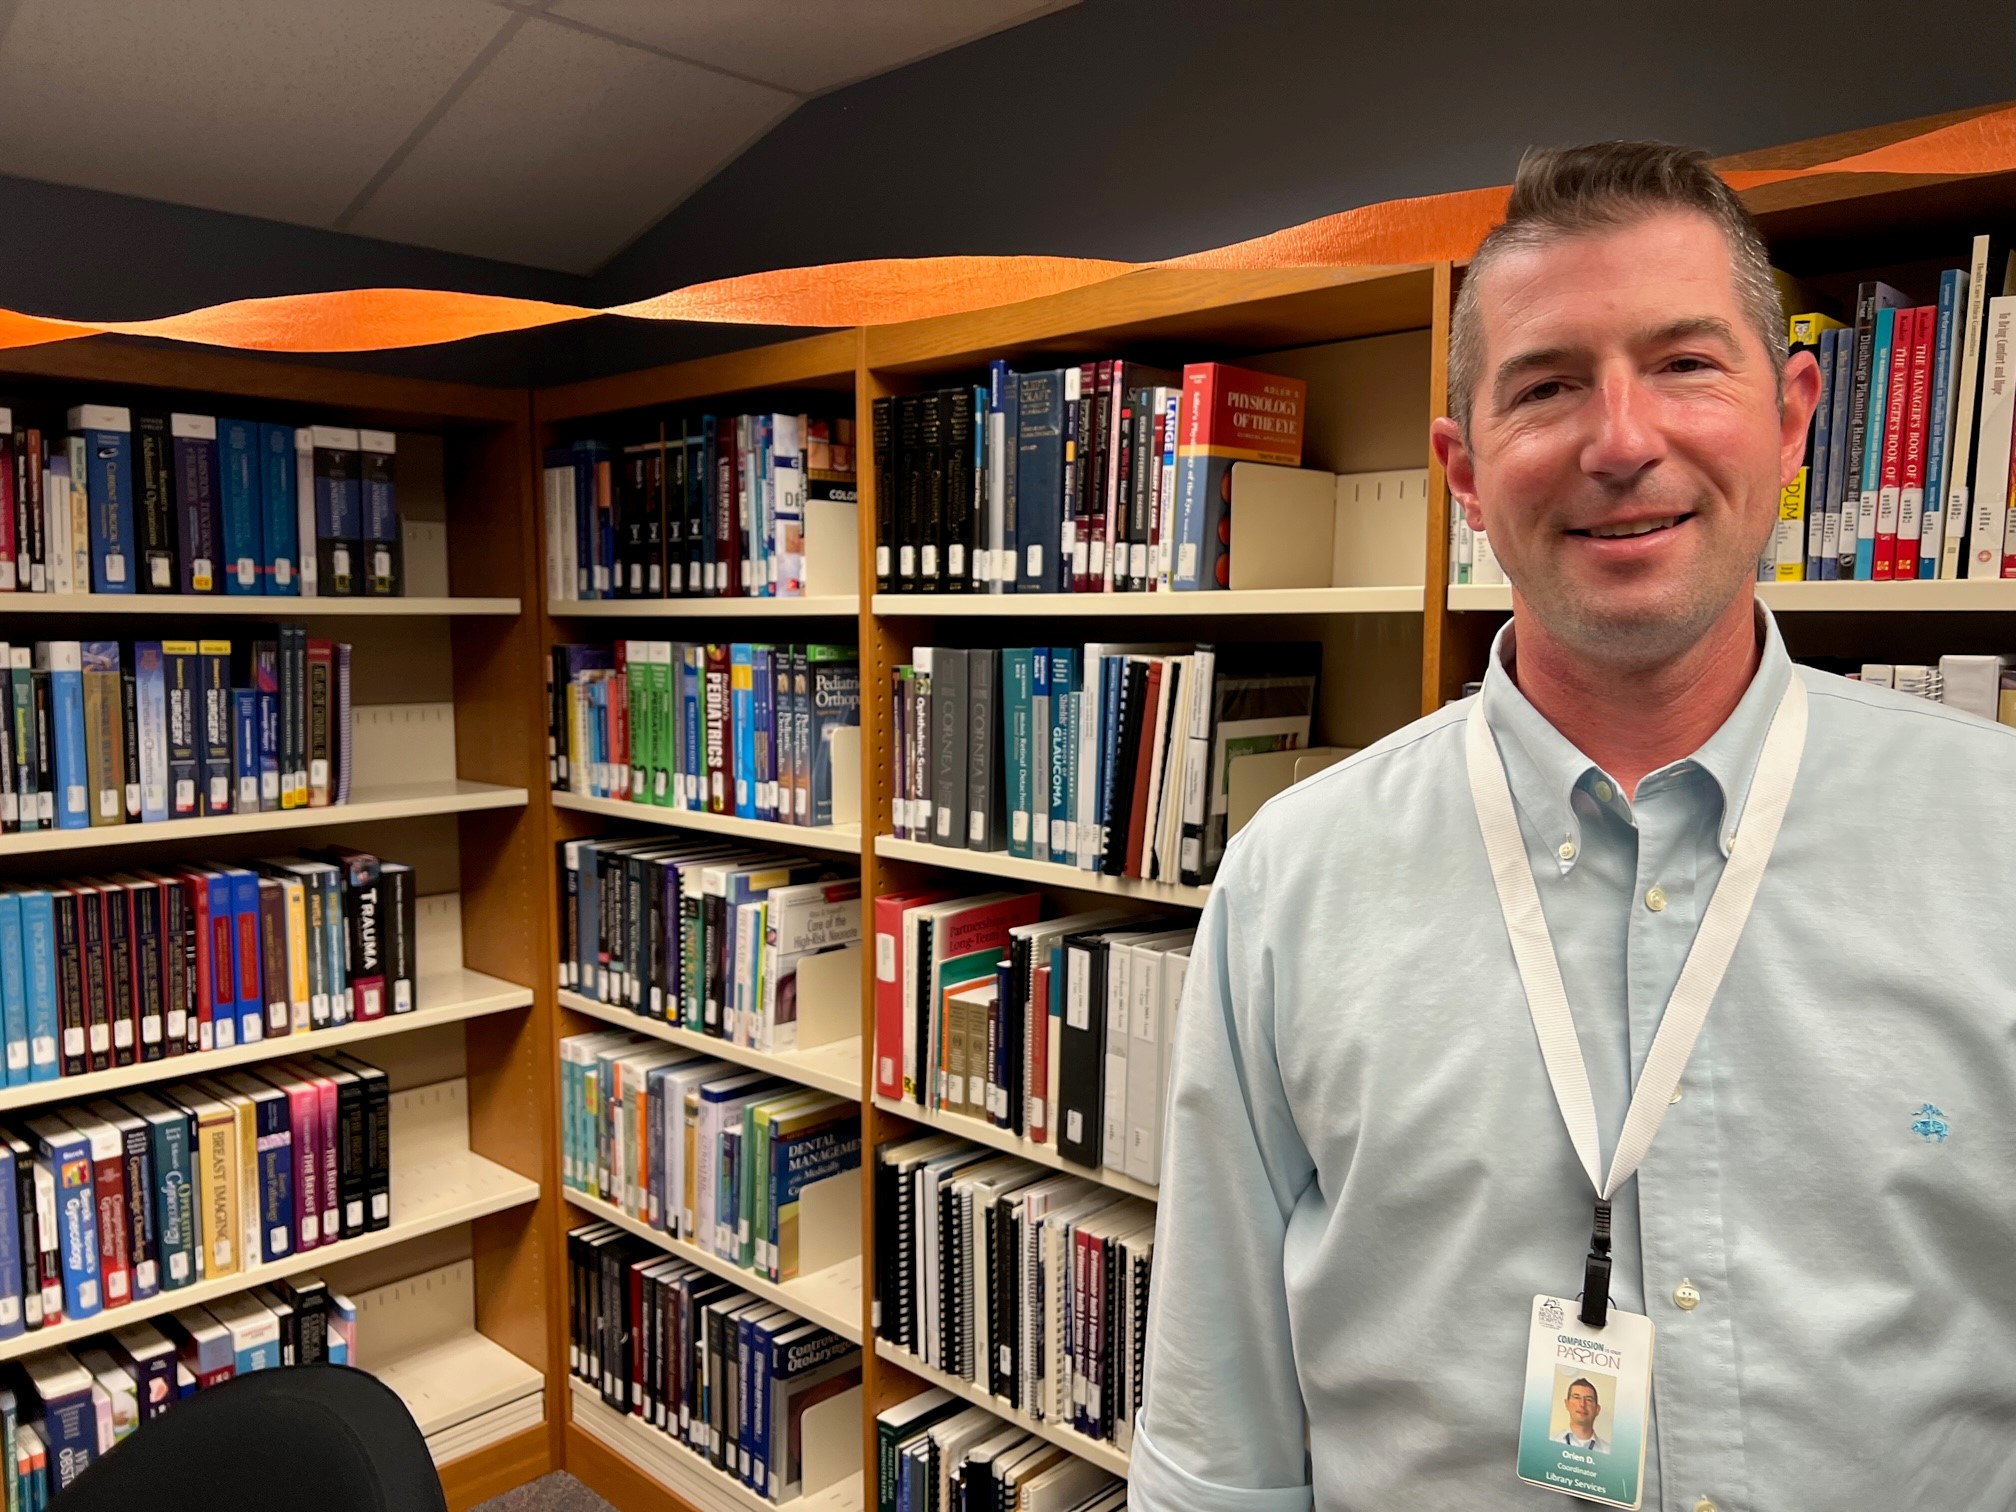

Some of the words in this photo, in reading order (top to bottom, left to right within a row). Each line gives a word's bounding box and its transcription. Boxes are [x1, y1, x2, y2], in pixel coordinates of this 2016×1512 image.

[1940, 311, 1950, 349] Performance
[1969, 321, 1978, 356] Committees
[1995, 320, 2009, 338] Bring
[1857, 335, 1871, 381] Discharge
[1895, 347, 1906, 368] THE
[1915, 344, 1926, 365] THE
[1995, 339, 2008, 364] Comfort
[1937, 350, 1947, 391] Improvement
[1995, 367, 2005, 378] and
[1890, 371, 1904, 430] MANAGER'S
[1911, 369, 1923, 428] MANAGER'S
[1992, 380, 2005, 395] Hope
[1192, 392, 1200, 420] Adler's
[1227, 391, 1297, 416] PHYSIOLOGY
[1852, 383, 1867, 424] Planning
[1164, 399, 1175, 452] LANGE
[1233, 411, 1250, 429] OF
[1251, 415, 1275, 432] THE
[1275, 418, 1298, 435] EYE
[1934, 425, 1942, 435] and
[1188, 422, 1197, 469] Physiology
[1849, 427, 1864, 472] Handbook
[1886, 434, 1898, 463] BOOK
[1907, 432, 1920, 460] BOOK
[1137, 447, 1145, 492] DIFFERENTIAL
[1187, 471, 1195, 480] of
[1848, 475, 1860, 489] for
[1885, 467, 1896, 480] OF
[1906, 465, 1916, 479] OF
[1930, 457, 1939, 481] Systems
[1186, 482, 1194, 496] the
[1183, 497, 1193, 516] Eye,
[815, 675, 859, 692] Pediatri
[170, 689, 183, 746] SURGERY
[183, 689, 191, 732] PRINCIPLES
[207, 689, 219, 745] SURGERY
[219, 689, 227, 732] PRINCIPLES
[706, 673, 722, 768] PEDIATRICS
[1059, 693, 1068, 727] Shields'
[184, 734, 191, 745] OF
[220, 734, 227, 744] OF
[915, 697, 925, 756] Ophthalmic
[940, 700, 955, 773] CORNEA
[972, 703, 985, 777] CORNEA
[777, 712, 785, 773] Orthopaedics
[1018, 738, 1027, 767] Retinal
[914, 756, 925, 797] Surgery
[1052, 727, 1062, 807] GLAUCOMA
[1018, 769, 1027, 811] Detachme
[360, 888, 378, 970] TRAUMA
[988, 1020, 996, 1053] ROBERT'S
[988, 1073, 995, 1082] OF
[212, 1131, 226, 1181] BREAST
[326, 1149, 336, 1169] THE
[788, 1134, 836, 1159] DENTAL
[788, 1138, 862, 1172] MANAGEME
[303, 1153, 313, 1174] THE
[304, 1175, 315, 1213] BREAST
[326, 1170, 338, 1207] BREAST
[161, 1171, 184, 1244] Gynecology
[65, 1198, 83, 1271] Gynecology
[1076, 1244, 1086, 1290] Cardiovascular
[1089, 1249, 1099, 1296] Cardiovascular
[1076, 1291, 1085, 1310] Health
[1089, 1298, 1099, 1317] Health
[1076, 1319, 1085, 1345] Services
[1089, 1324, 1098, 1351] Services
[1557, 1334, 1605, 1352] COMPASSION
[1557, 1462, 1598, 1478] Coordinator
[1562, 1450, 1585, 1463] Orien
[1586, 1456, 1596, 1465] D.
[1545, 1471, 1574, 1487] Library
[1574, 1479, 1607, 1494] Services
